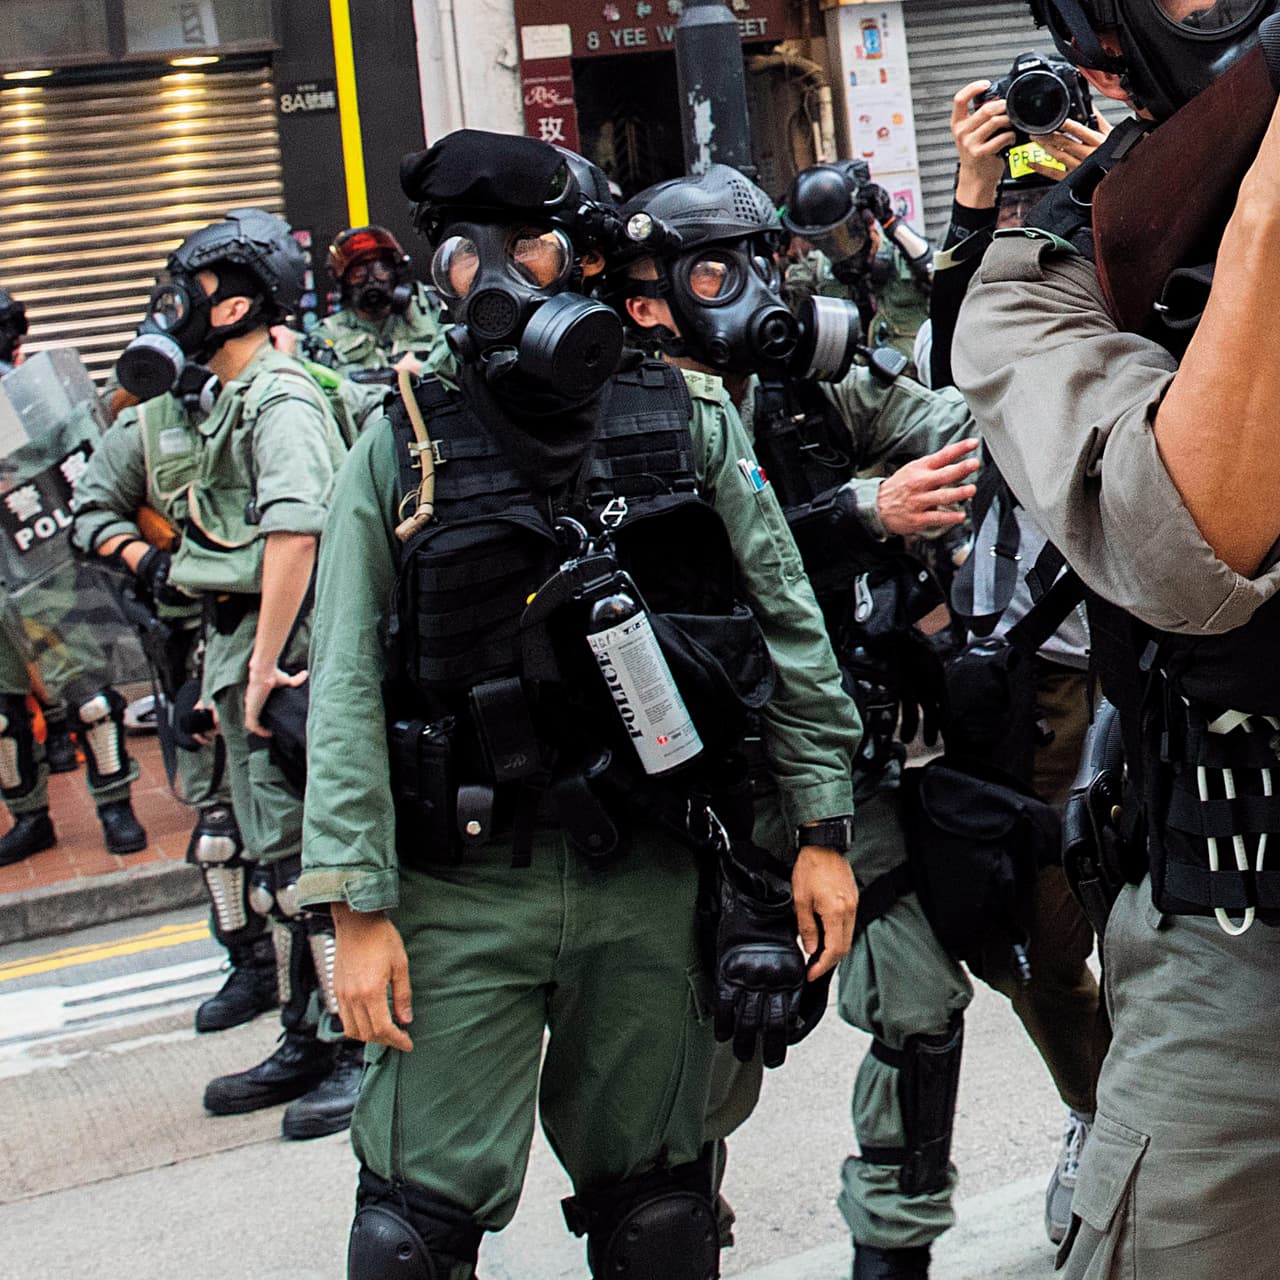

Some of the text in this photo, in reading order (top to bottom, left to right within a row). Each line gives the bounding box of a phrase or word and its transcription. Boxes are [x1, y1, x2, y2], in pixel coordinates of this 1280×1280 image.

[587, 30, 600, 50] 8
[610, 27, 648, 47] YEE
[656, 25, 675, 43] W
[738, 17, 768, 37] EET
[14, 505, 75, 551] POL
[596, 650, 644, 739] POLICE
